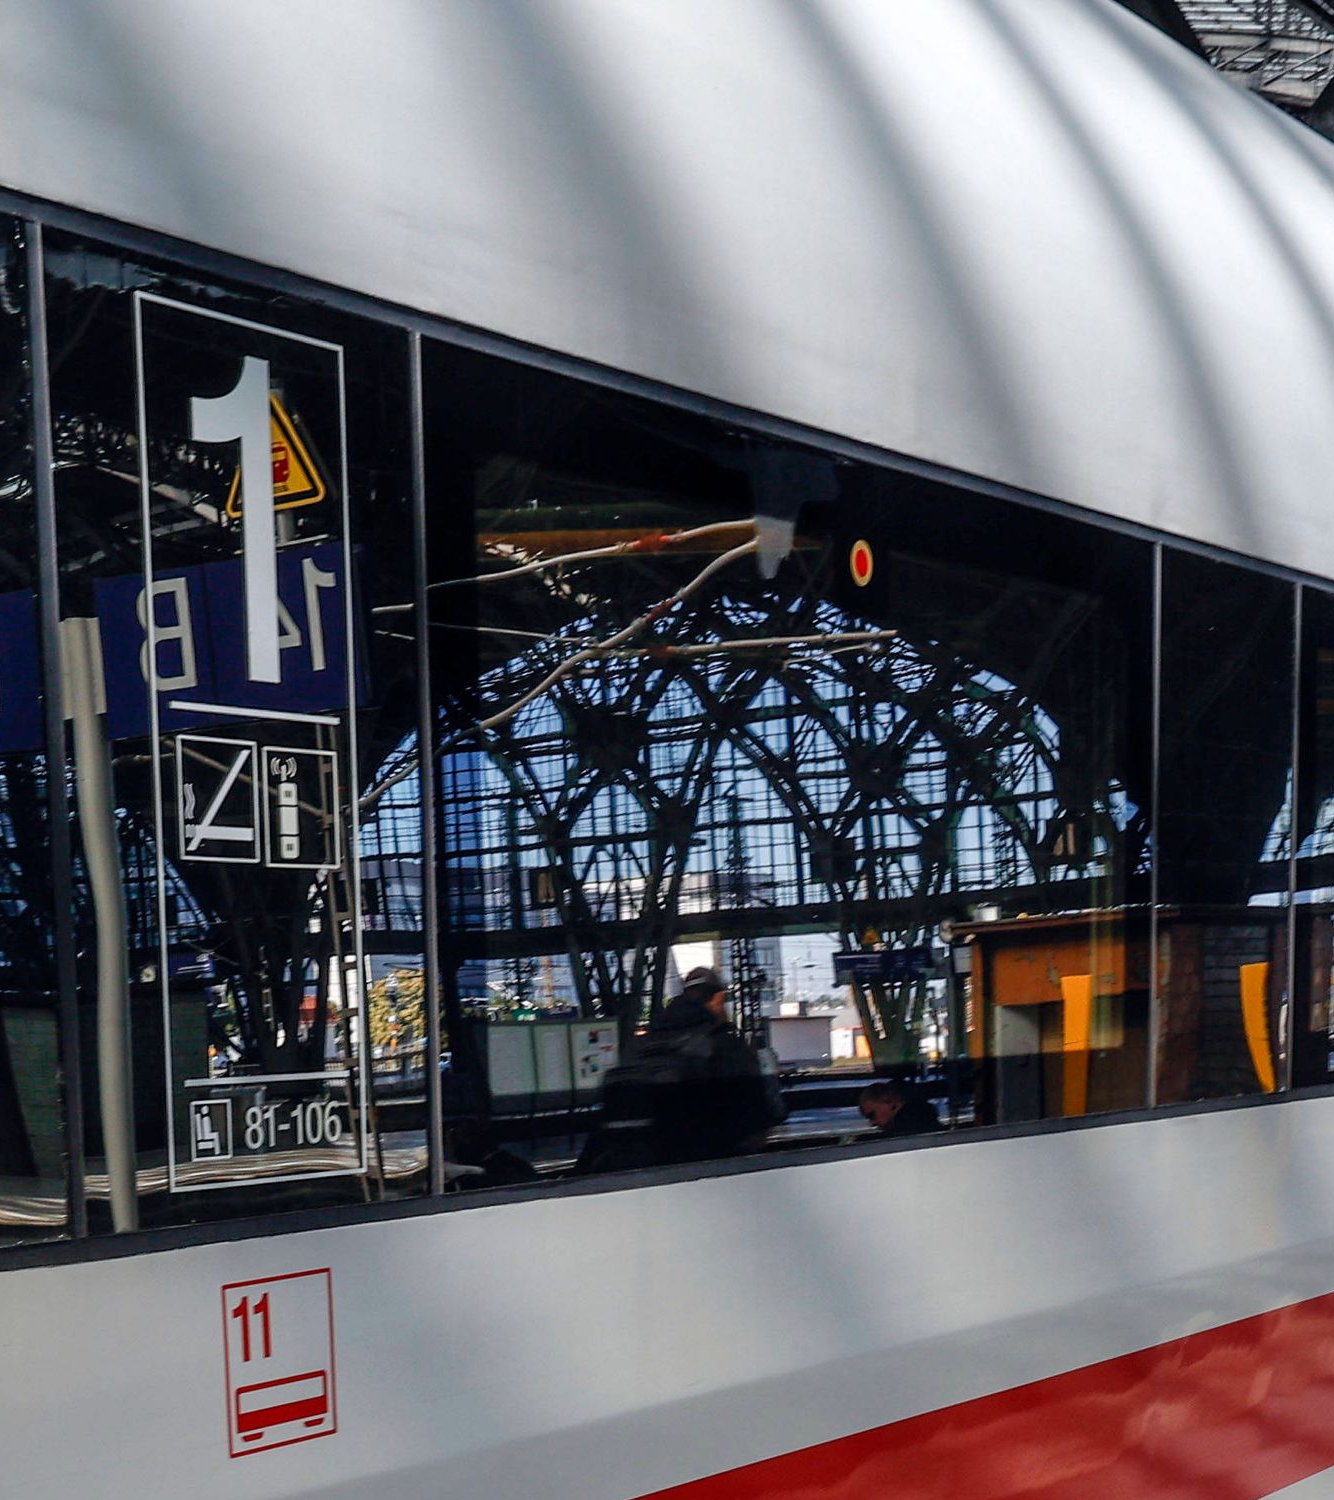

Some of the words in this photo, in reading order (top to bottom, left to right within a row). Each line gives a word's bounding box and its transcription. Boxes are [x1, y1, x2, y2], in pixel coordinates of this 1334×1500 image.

[189, 355, 281, 684] 1
[244, 1098, 343, 1151] 81-106
[231, 1292, 273, 1363] 11
